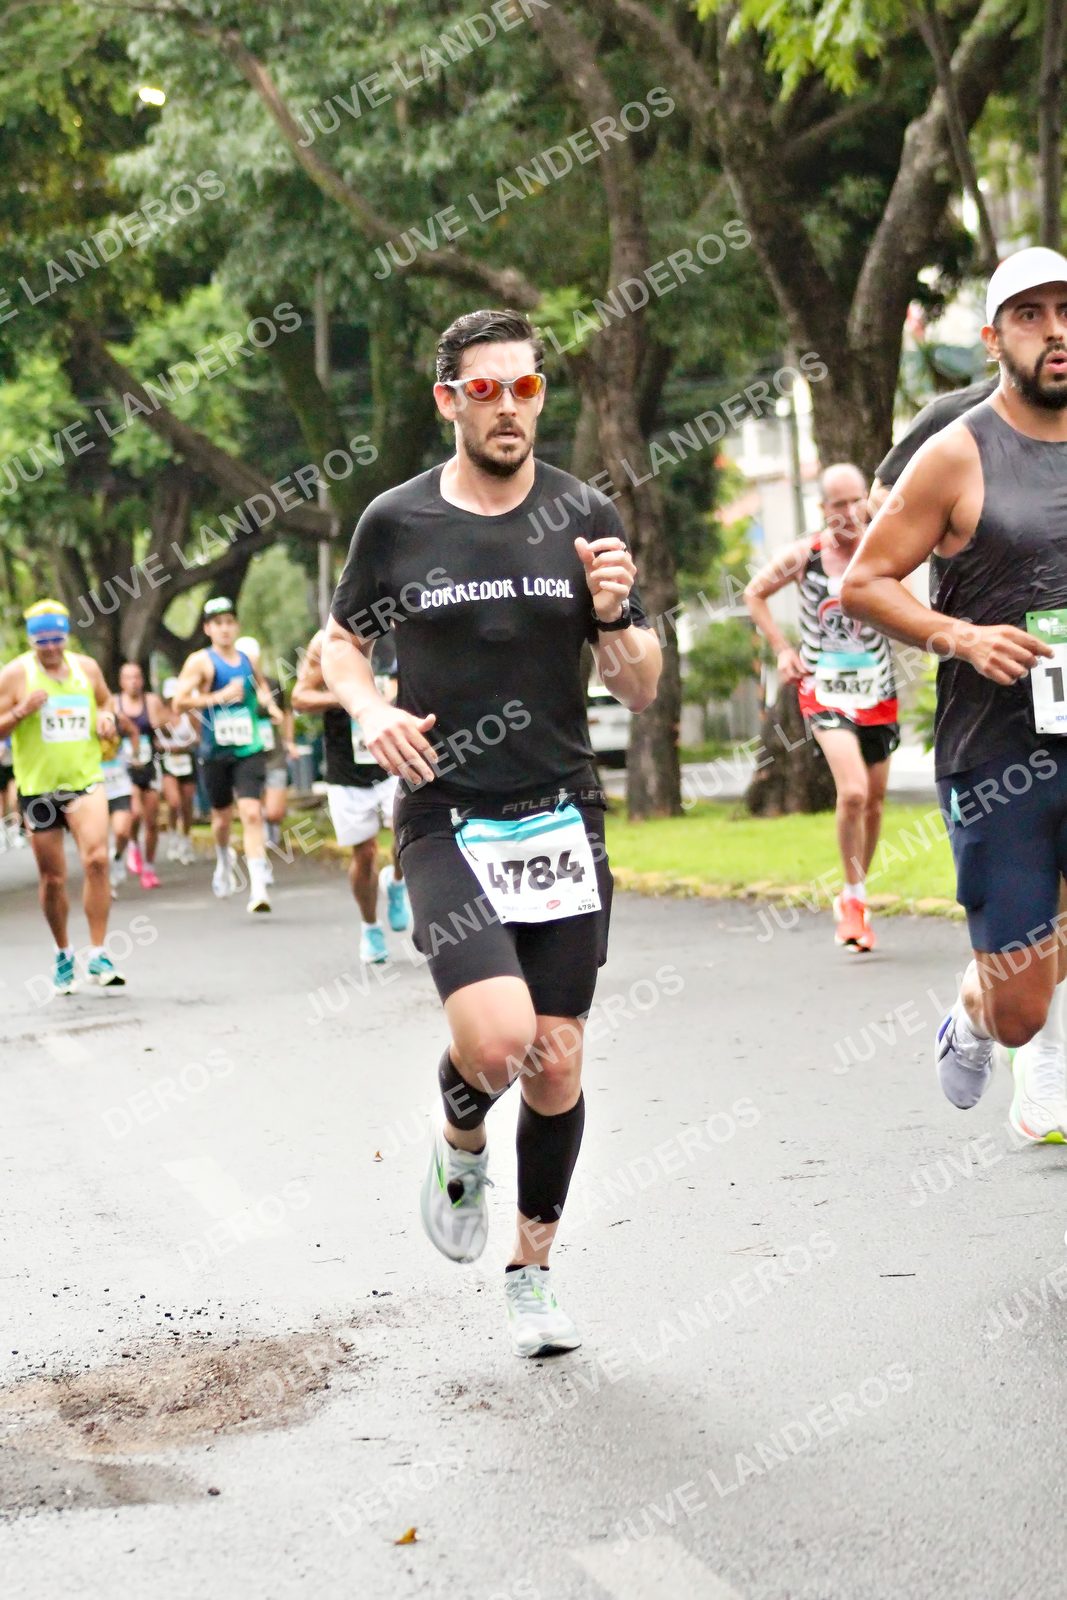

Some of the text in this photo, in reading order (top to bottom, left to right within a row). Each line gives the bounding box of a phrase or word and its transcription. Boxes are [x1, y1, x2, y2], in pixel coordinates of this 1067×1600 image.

[420, 576, 574, 609] CORREDOR LOCAL
[486, 849, 586, 895] 4784
[577, 903, 596, 911] 4784
